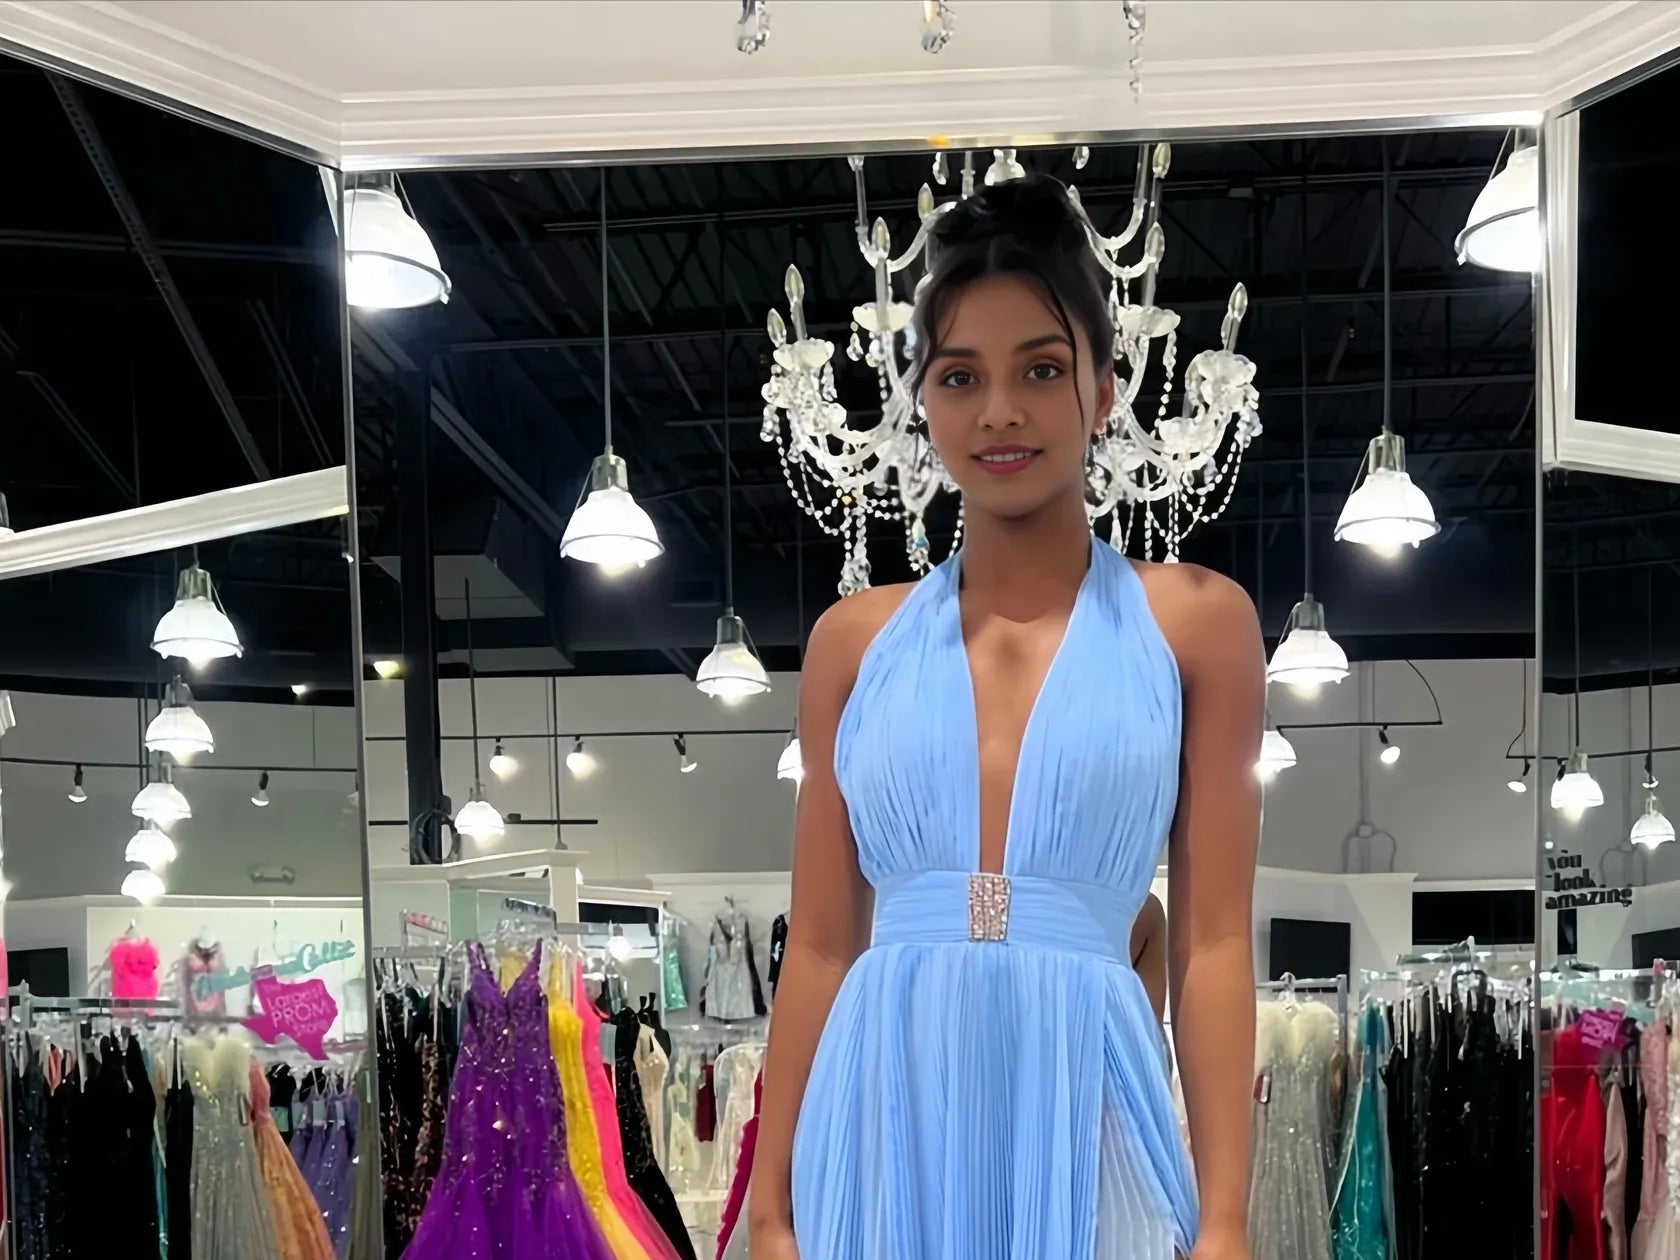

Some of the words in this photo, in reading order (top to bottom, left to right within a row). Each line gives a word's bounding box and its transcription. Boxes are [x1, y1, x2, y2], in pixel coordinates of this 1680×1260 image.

[1554, 868, 1597, 892] look
[1545, 884, 1633, 910] amazing
[272, 1000, 331, 1029] PROM
